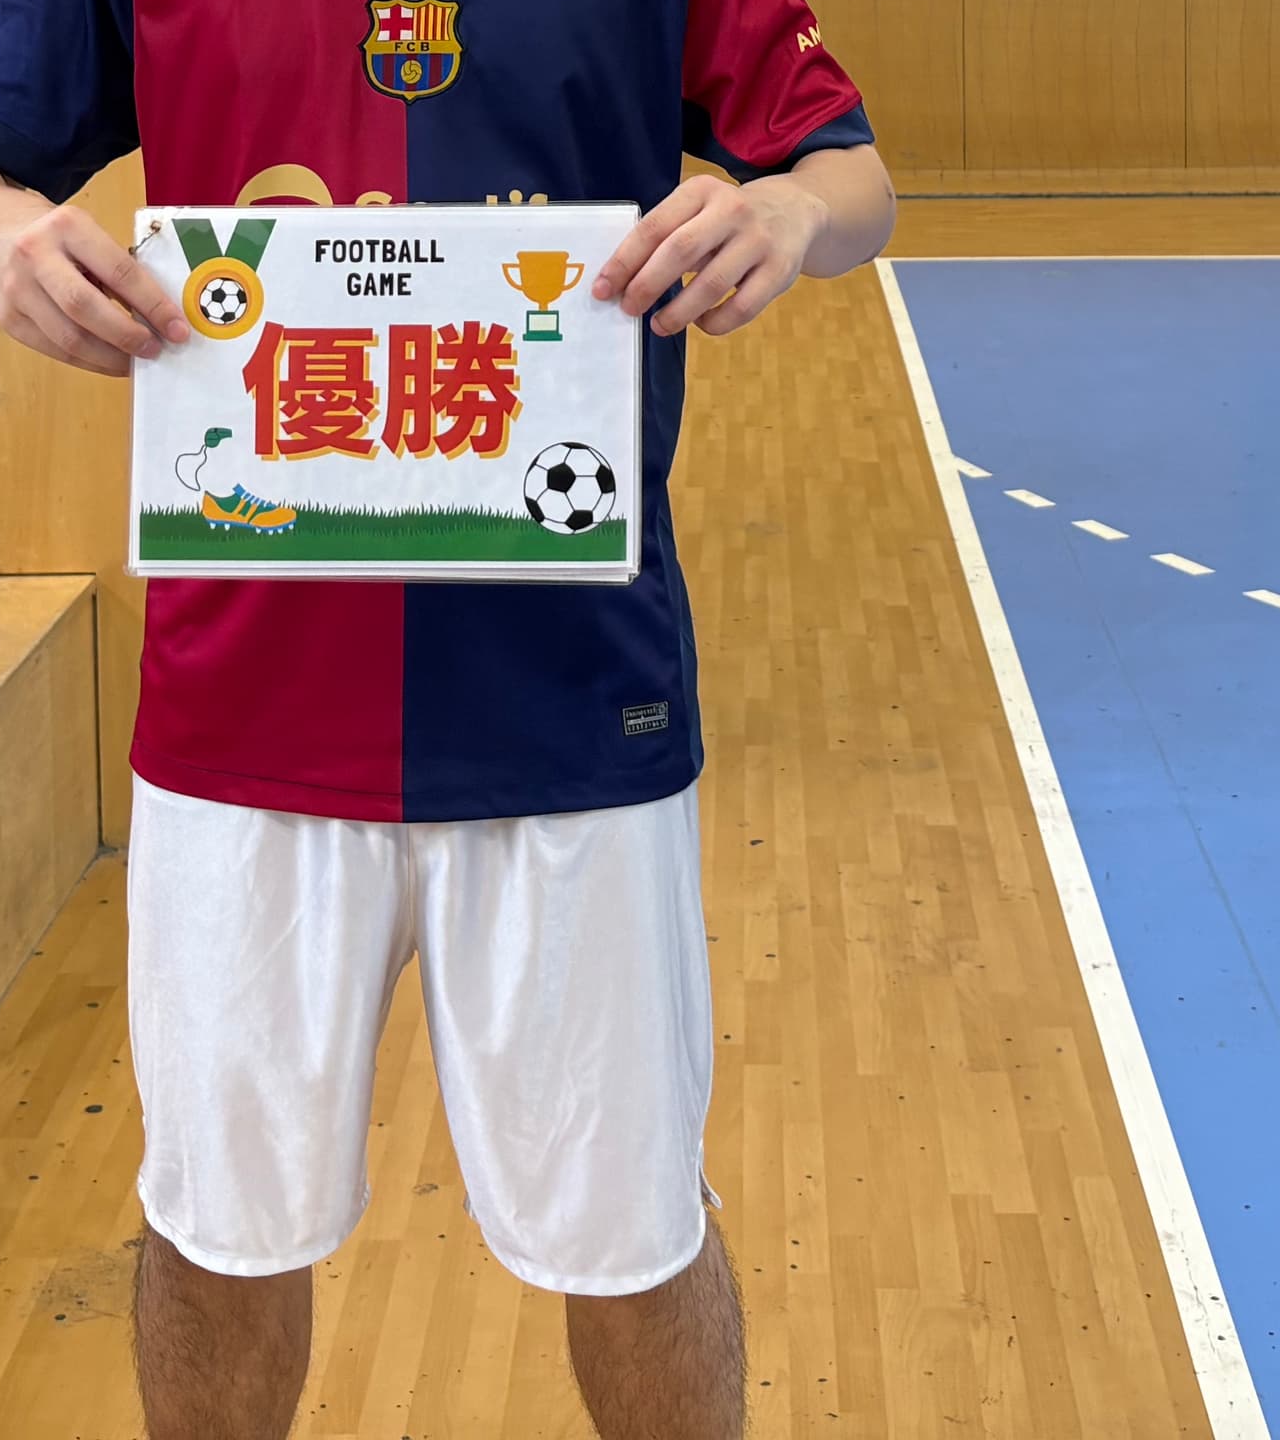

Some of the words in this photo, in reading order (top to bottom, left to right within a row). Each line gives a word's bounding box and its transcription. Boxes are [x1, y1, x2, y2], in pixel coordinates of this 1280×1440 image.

[394, 41, 430, 52] FCB
[314, 239, 446, 264] FOOTBALL
[346, 272, 413, 297] GAME
[242, 320, 522, 459] 優勝
